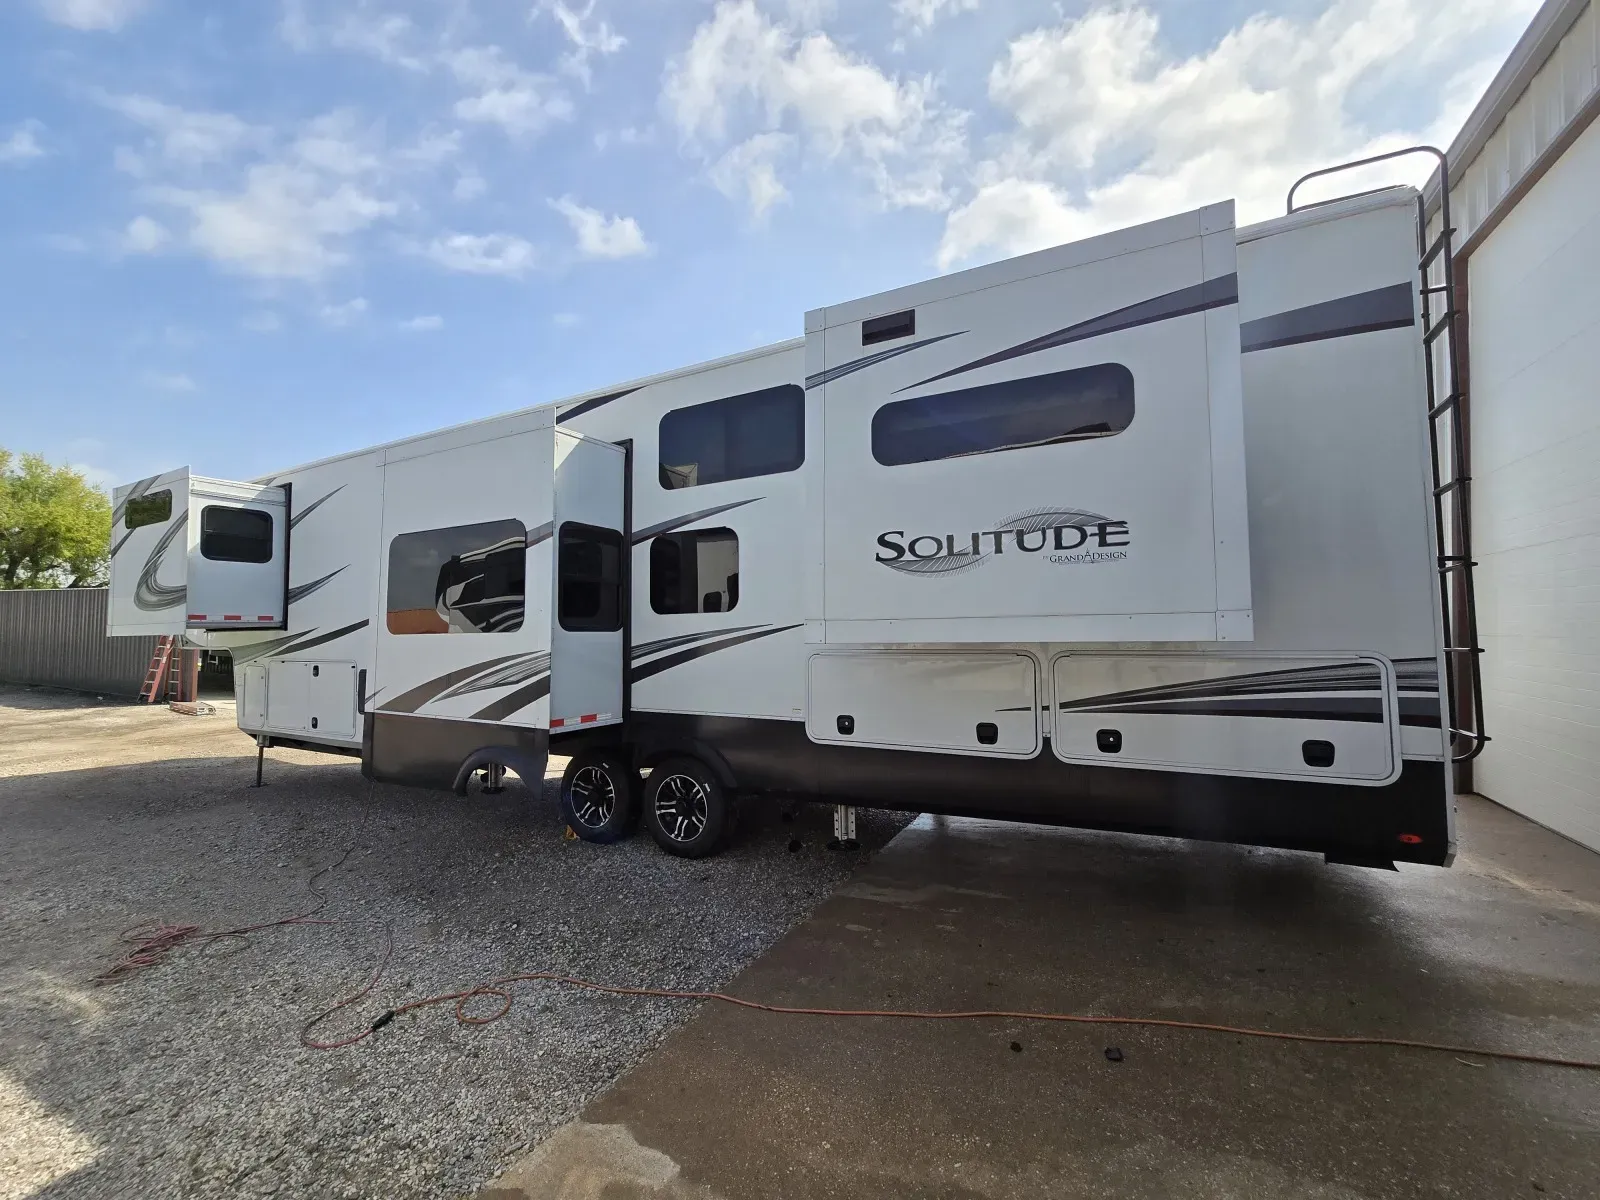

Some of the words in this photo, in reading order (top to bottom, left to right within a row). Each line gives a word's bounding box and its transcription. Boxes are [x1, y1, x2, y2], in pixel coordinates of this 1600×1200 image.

[875, 520, 1131, 562] SOLITUDE
[1049, 554, 1084, 563] GRAND
[1092, 551, 1127, 560] DESIGN
